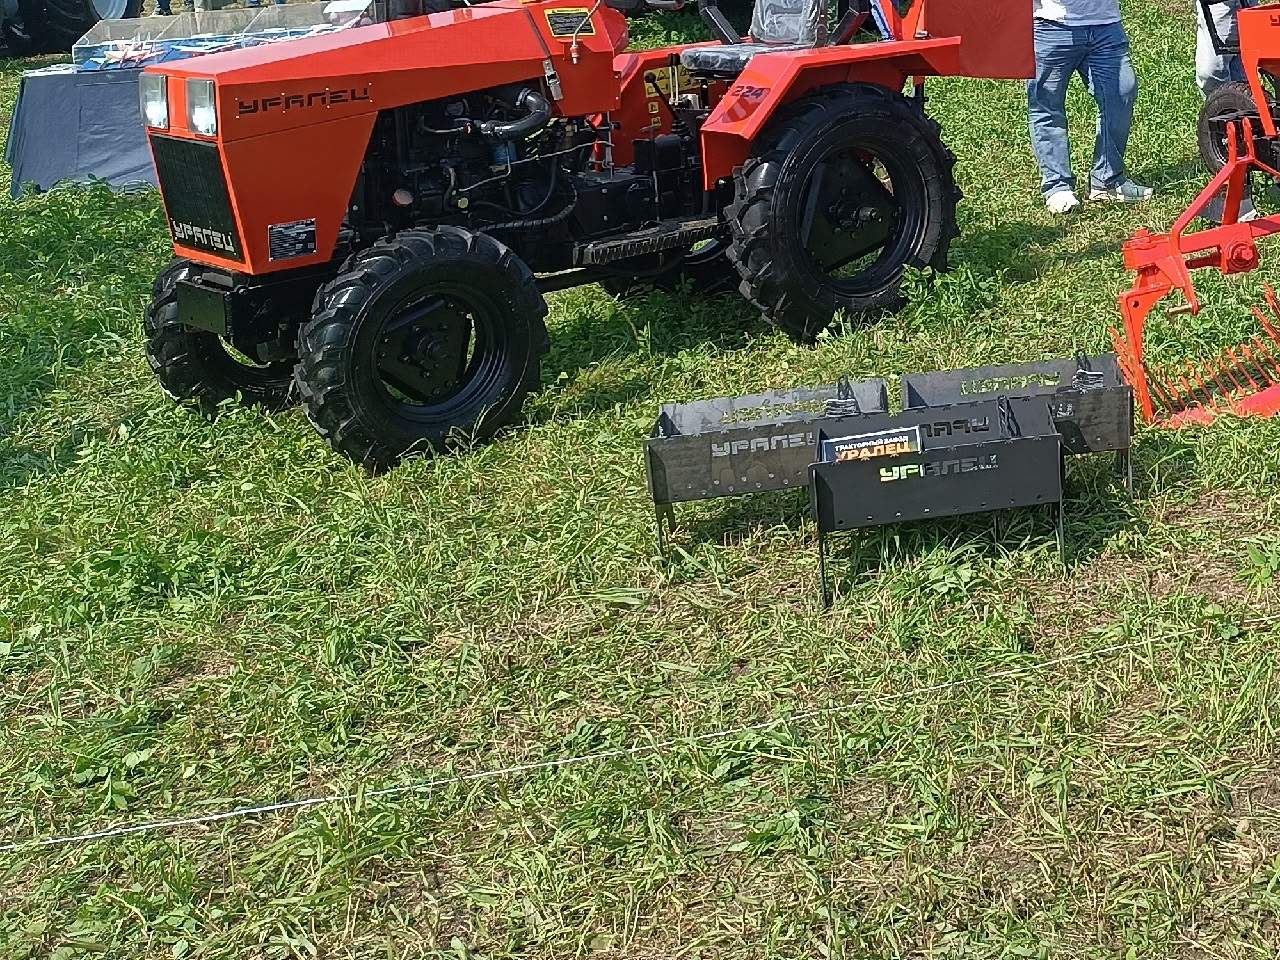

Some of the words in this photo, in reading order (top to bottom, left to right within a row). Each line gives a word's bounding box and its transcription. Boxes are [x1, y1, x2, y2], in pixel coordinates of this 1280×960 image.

[238, 87, 371, 117] УРАЛЕЦ
[172, 220, 235, 253] УРАЛЕЦ
[834, 437, 884, 452] ТРАКТОРНЫЙ
[835, 442, 911, 462] УРАЛЕЦ
[878, 453, 999, 482] УРАЛЕЦ
